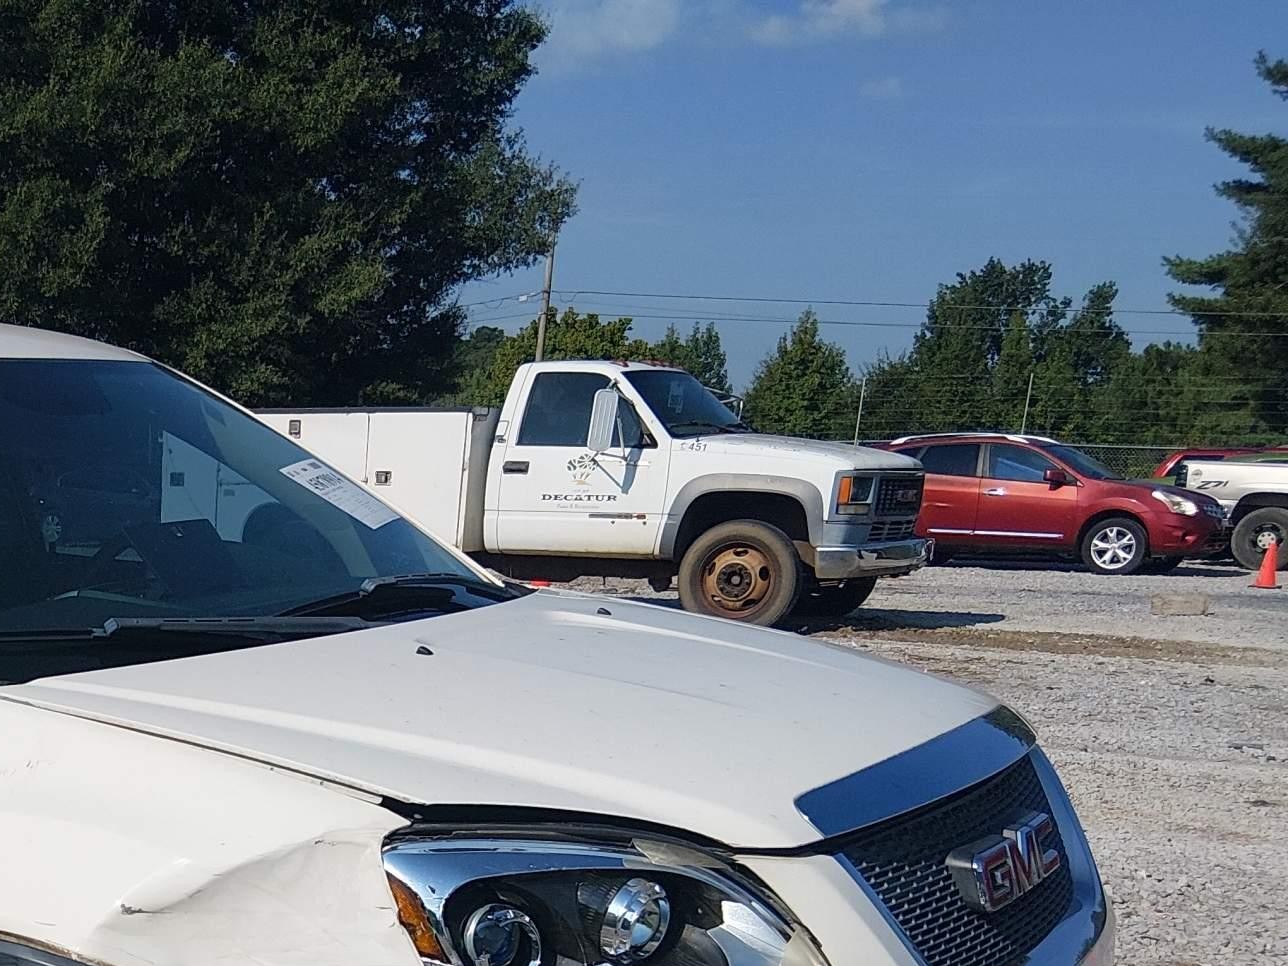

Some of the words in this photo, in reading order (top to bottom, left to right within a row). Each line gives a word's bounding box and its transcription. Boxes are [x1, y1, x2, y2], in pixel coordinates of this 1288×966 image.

[688, 442, 708, 452] 451
[541, 494, 617, 502] DECATUR
[970, 812, 1061, 912] GMC
